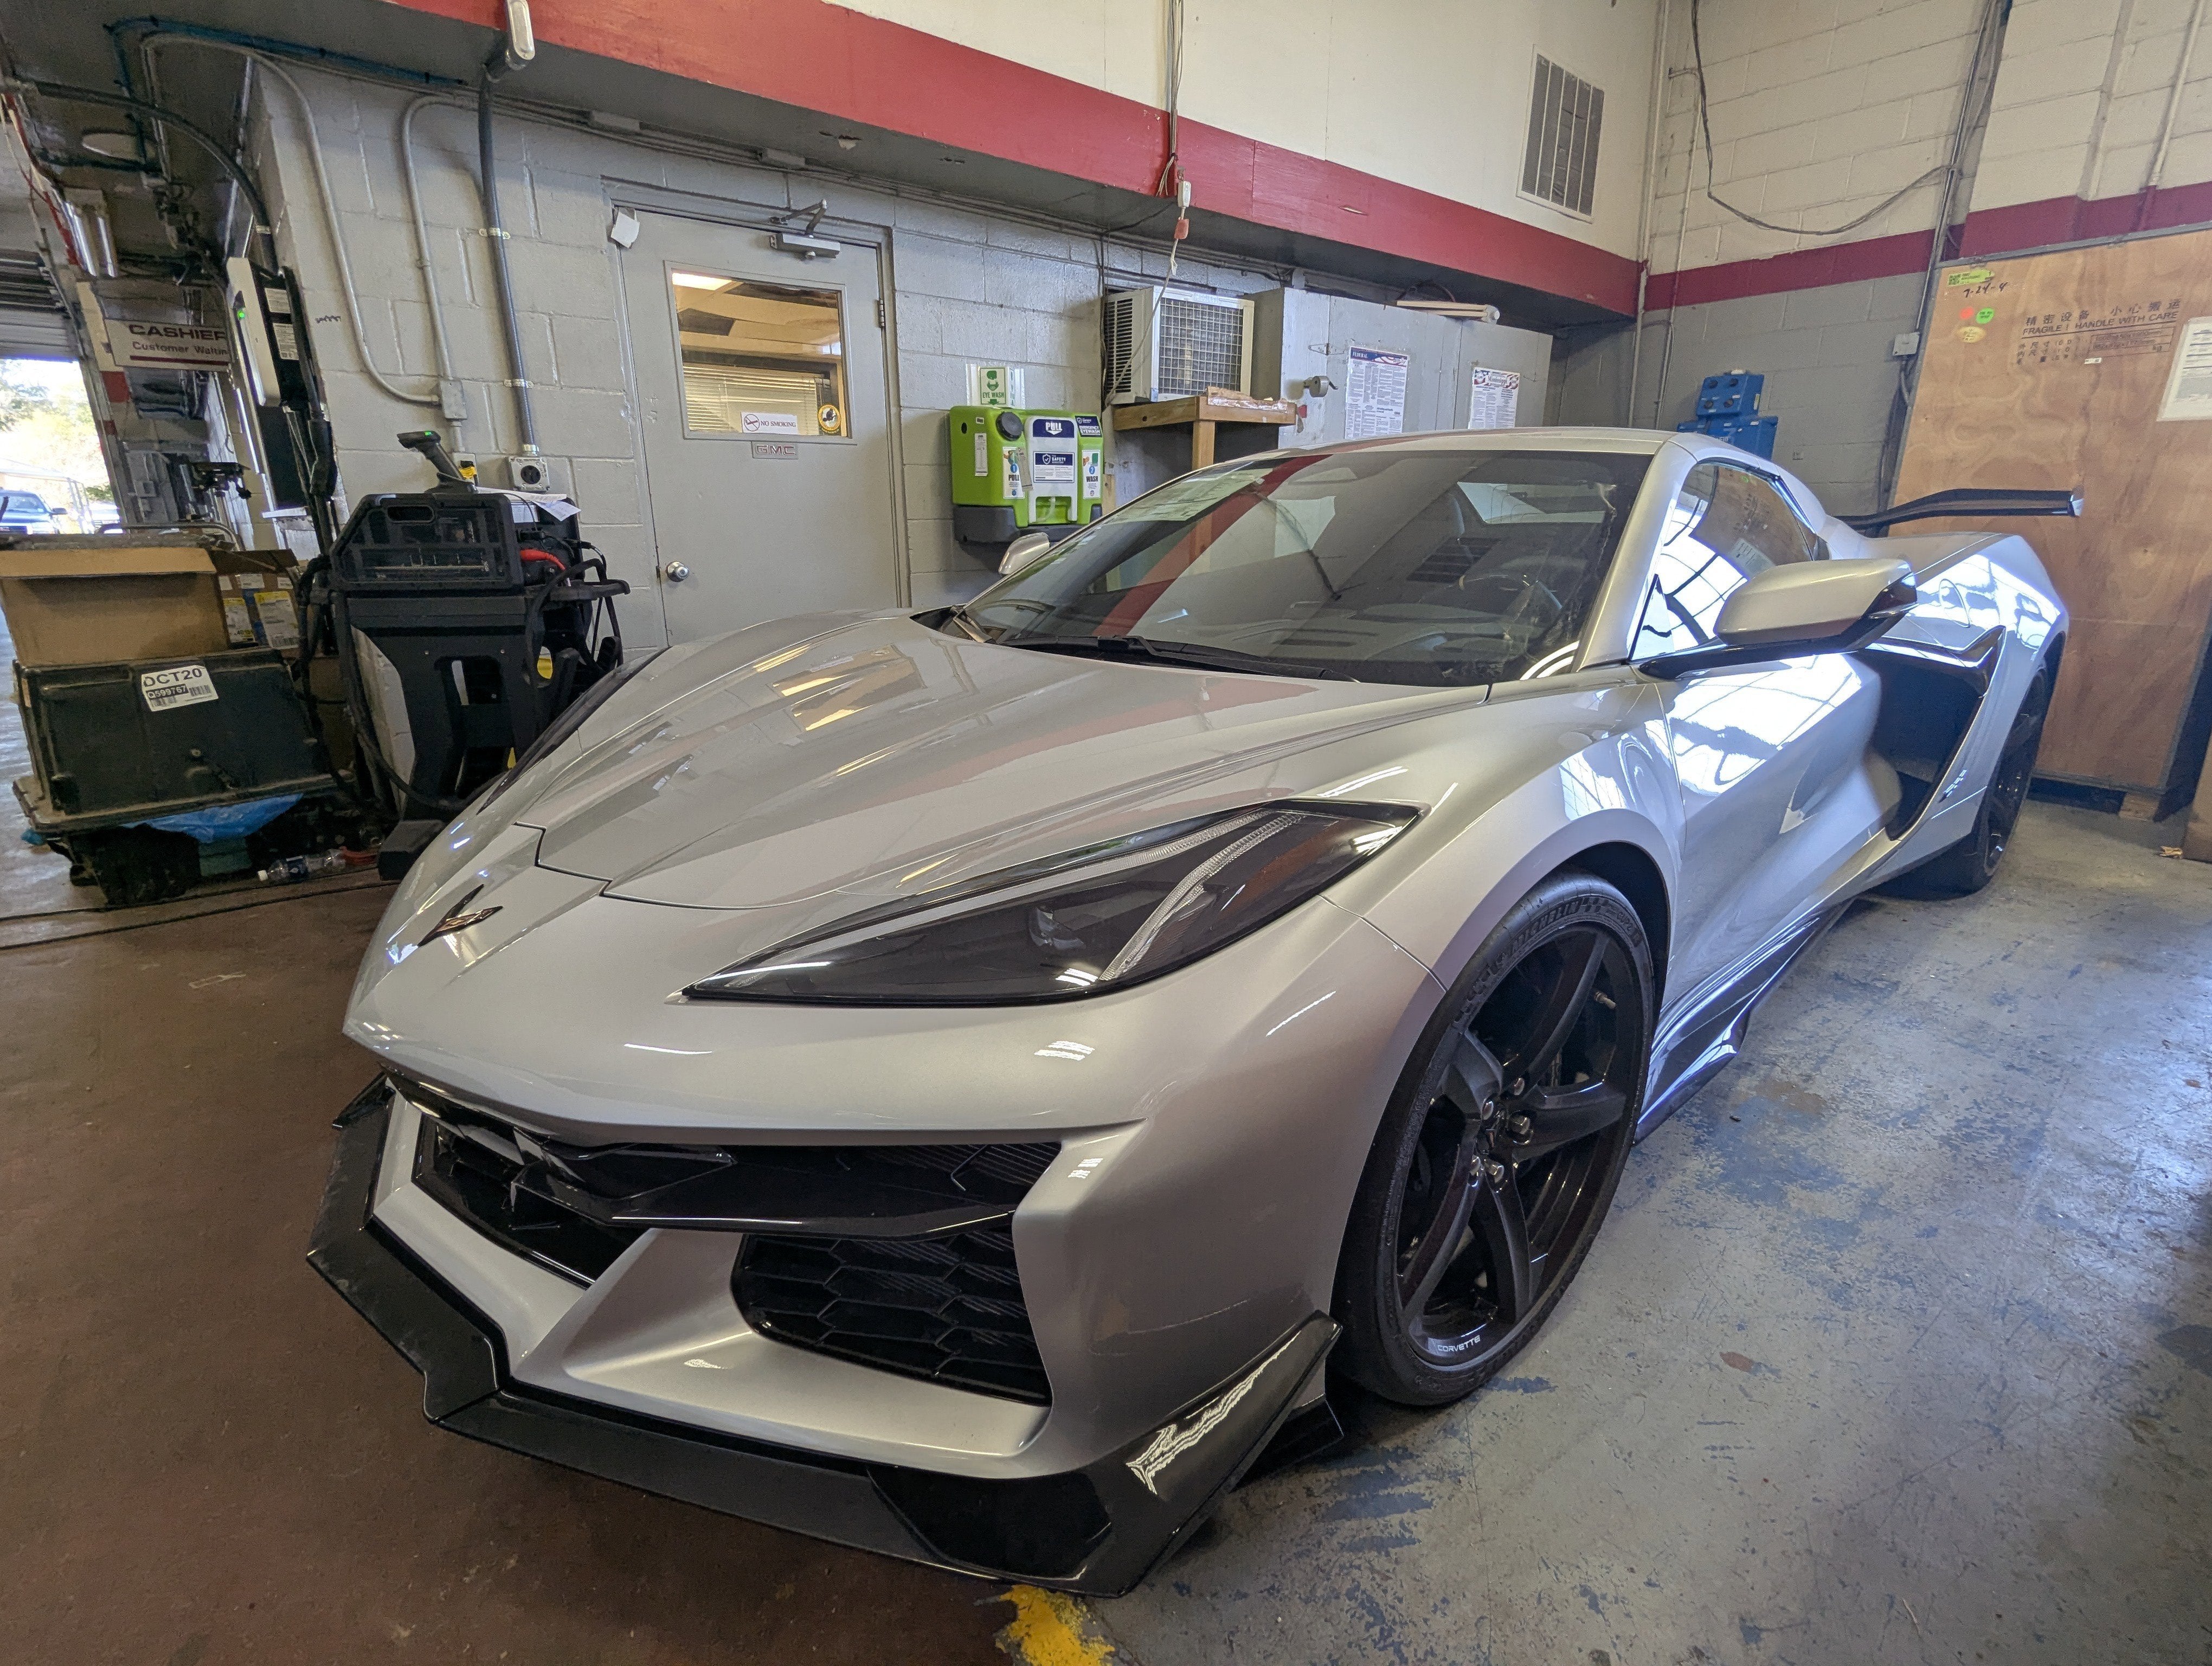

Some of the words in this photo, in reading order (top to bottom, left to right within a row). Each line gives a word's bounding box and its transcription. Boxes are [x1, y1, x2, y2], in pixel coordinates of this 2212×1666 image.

[2022, 324, 2062, 335] FRAGILE
[2075, 318, 2114, 329] HANDLE
[2118, 315, 2145, 324] WITH
[2149, 311, 2178, 321] CARE
[132, 341, 189, 353] Customer
[194, 345, 229, 355] Waitin
[1045, 422, 1063, 431] PULL
[755, 444, 796, 456] GMC
[1512, 900, 1580, 950] MICHELIN
[1438, 1335, 1481, 1352] CORVETTE
